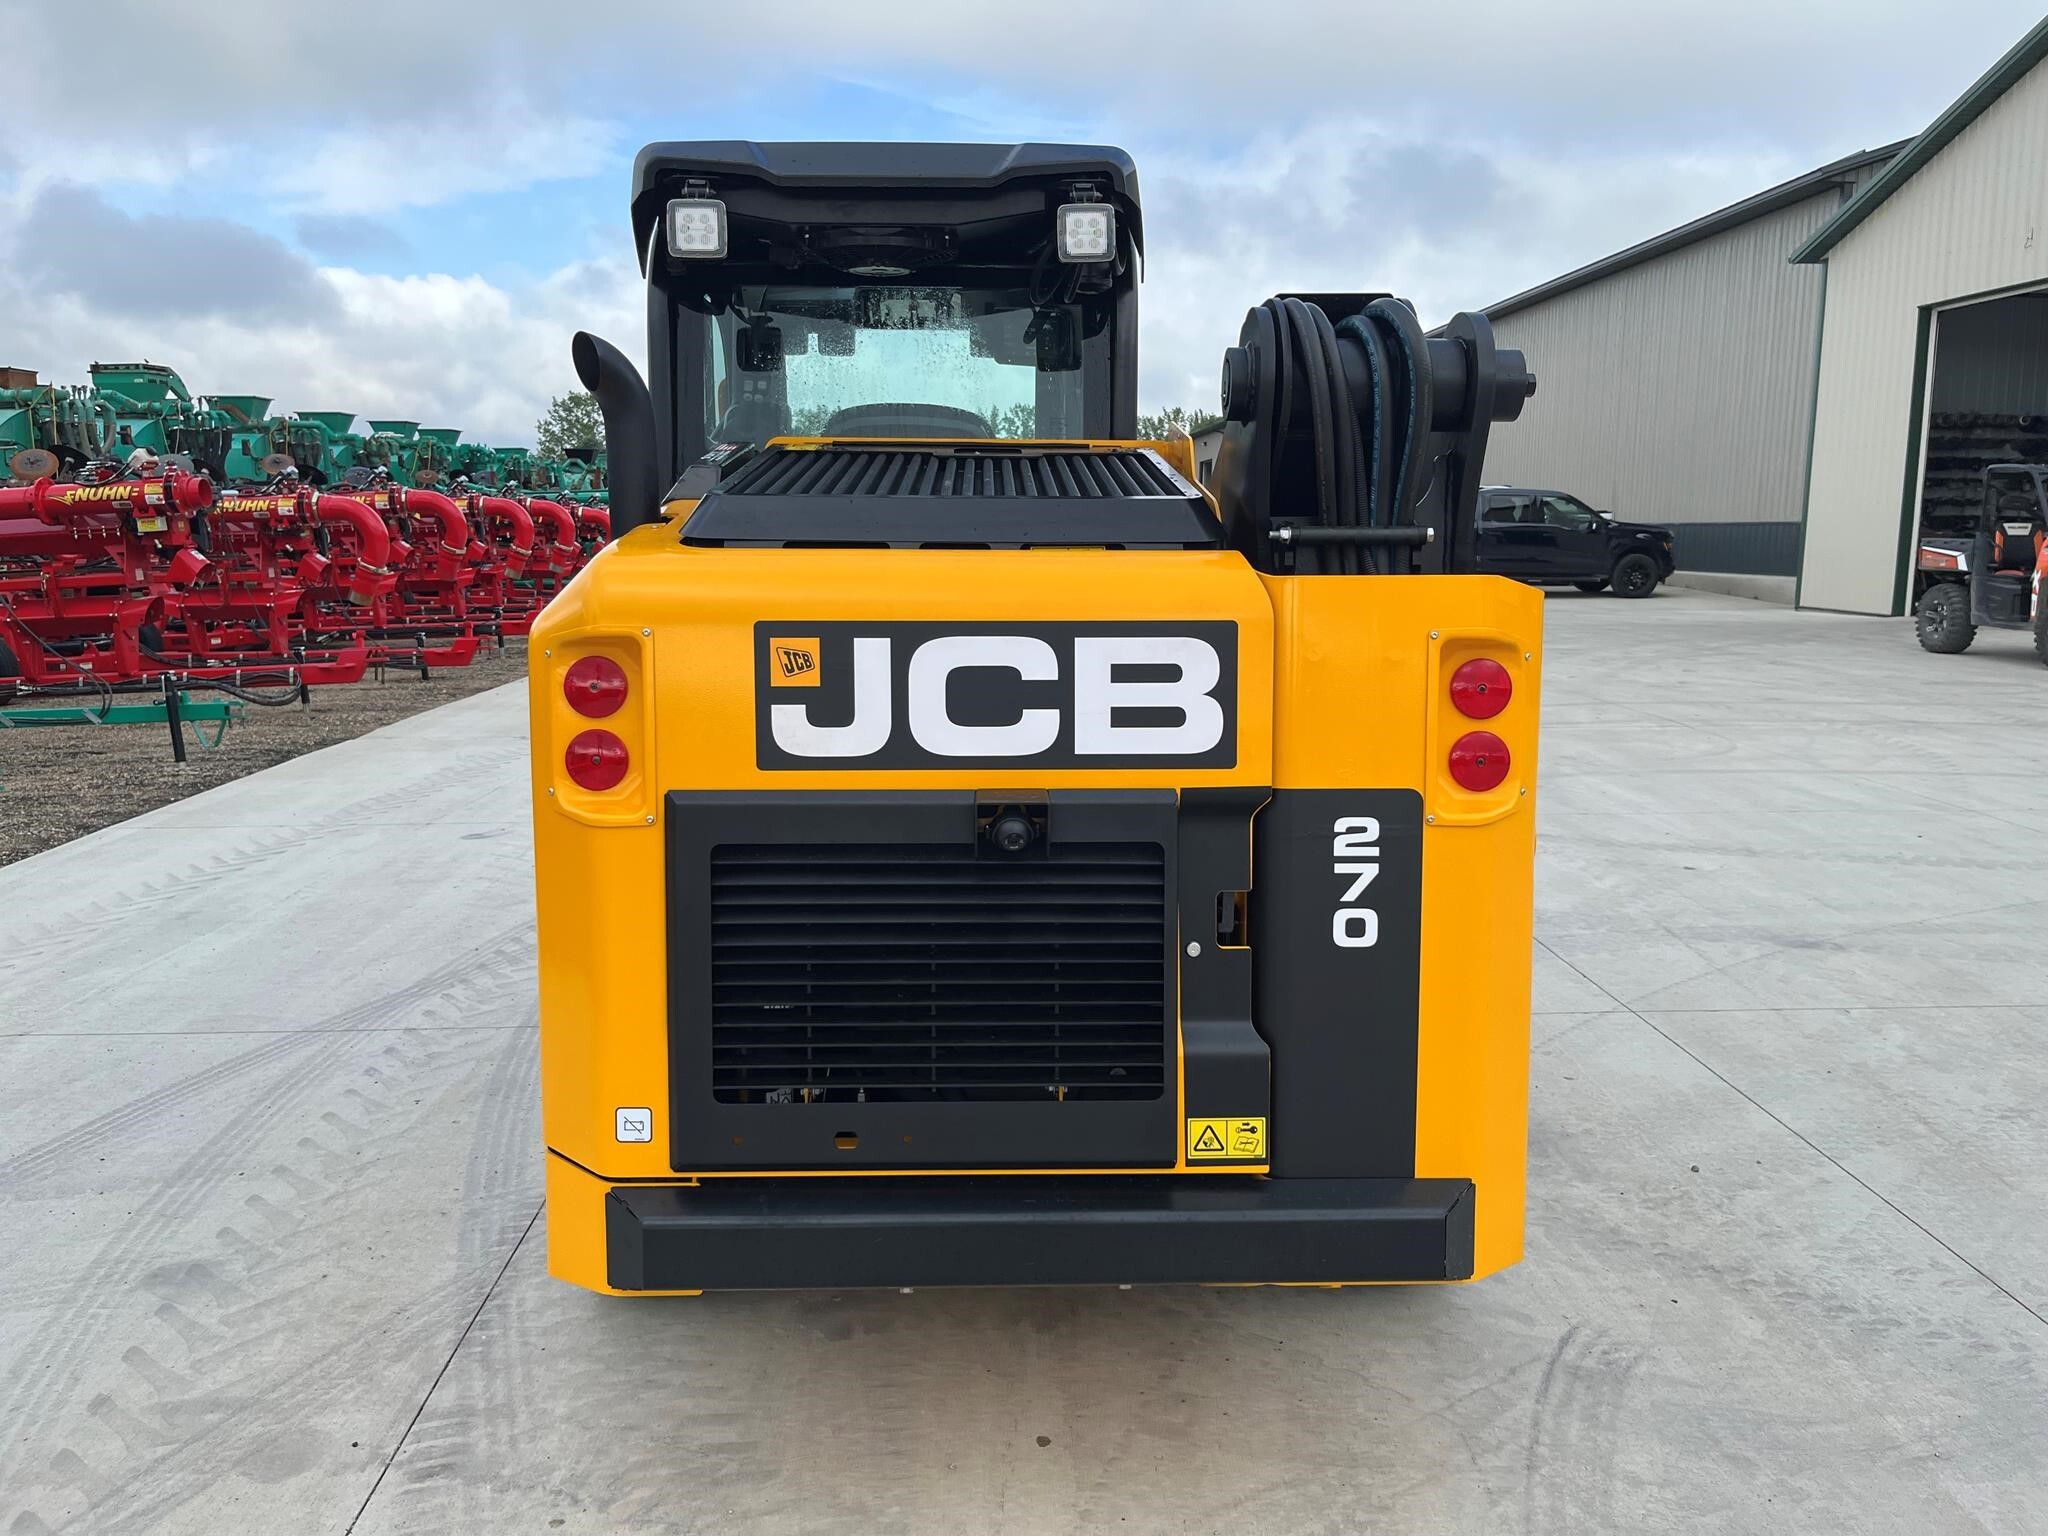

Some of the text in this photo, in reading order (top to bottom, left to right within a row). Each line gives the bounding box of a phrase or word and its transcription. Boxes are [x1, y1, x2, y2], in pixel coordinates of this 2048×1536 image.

[74, 486, 132, 501] NUHN
[223, 500, 270, 512] NUHN
[783, 650, 813, 674] JCB
[770, 636, 1224, 757] JCB
[1333, 817, 1380, 947] 270
